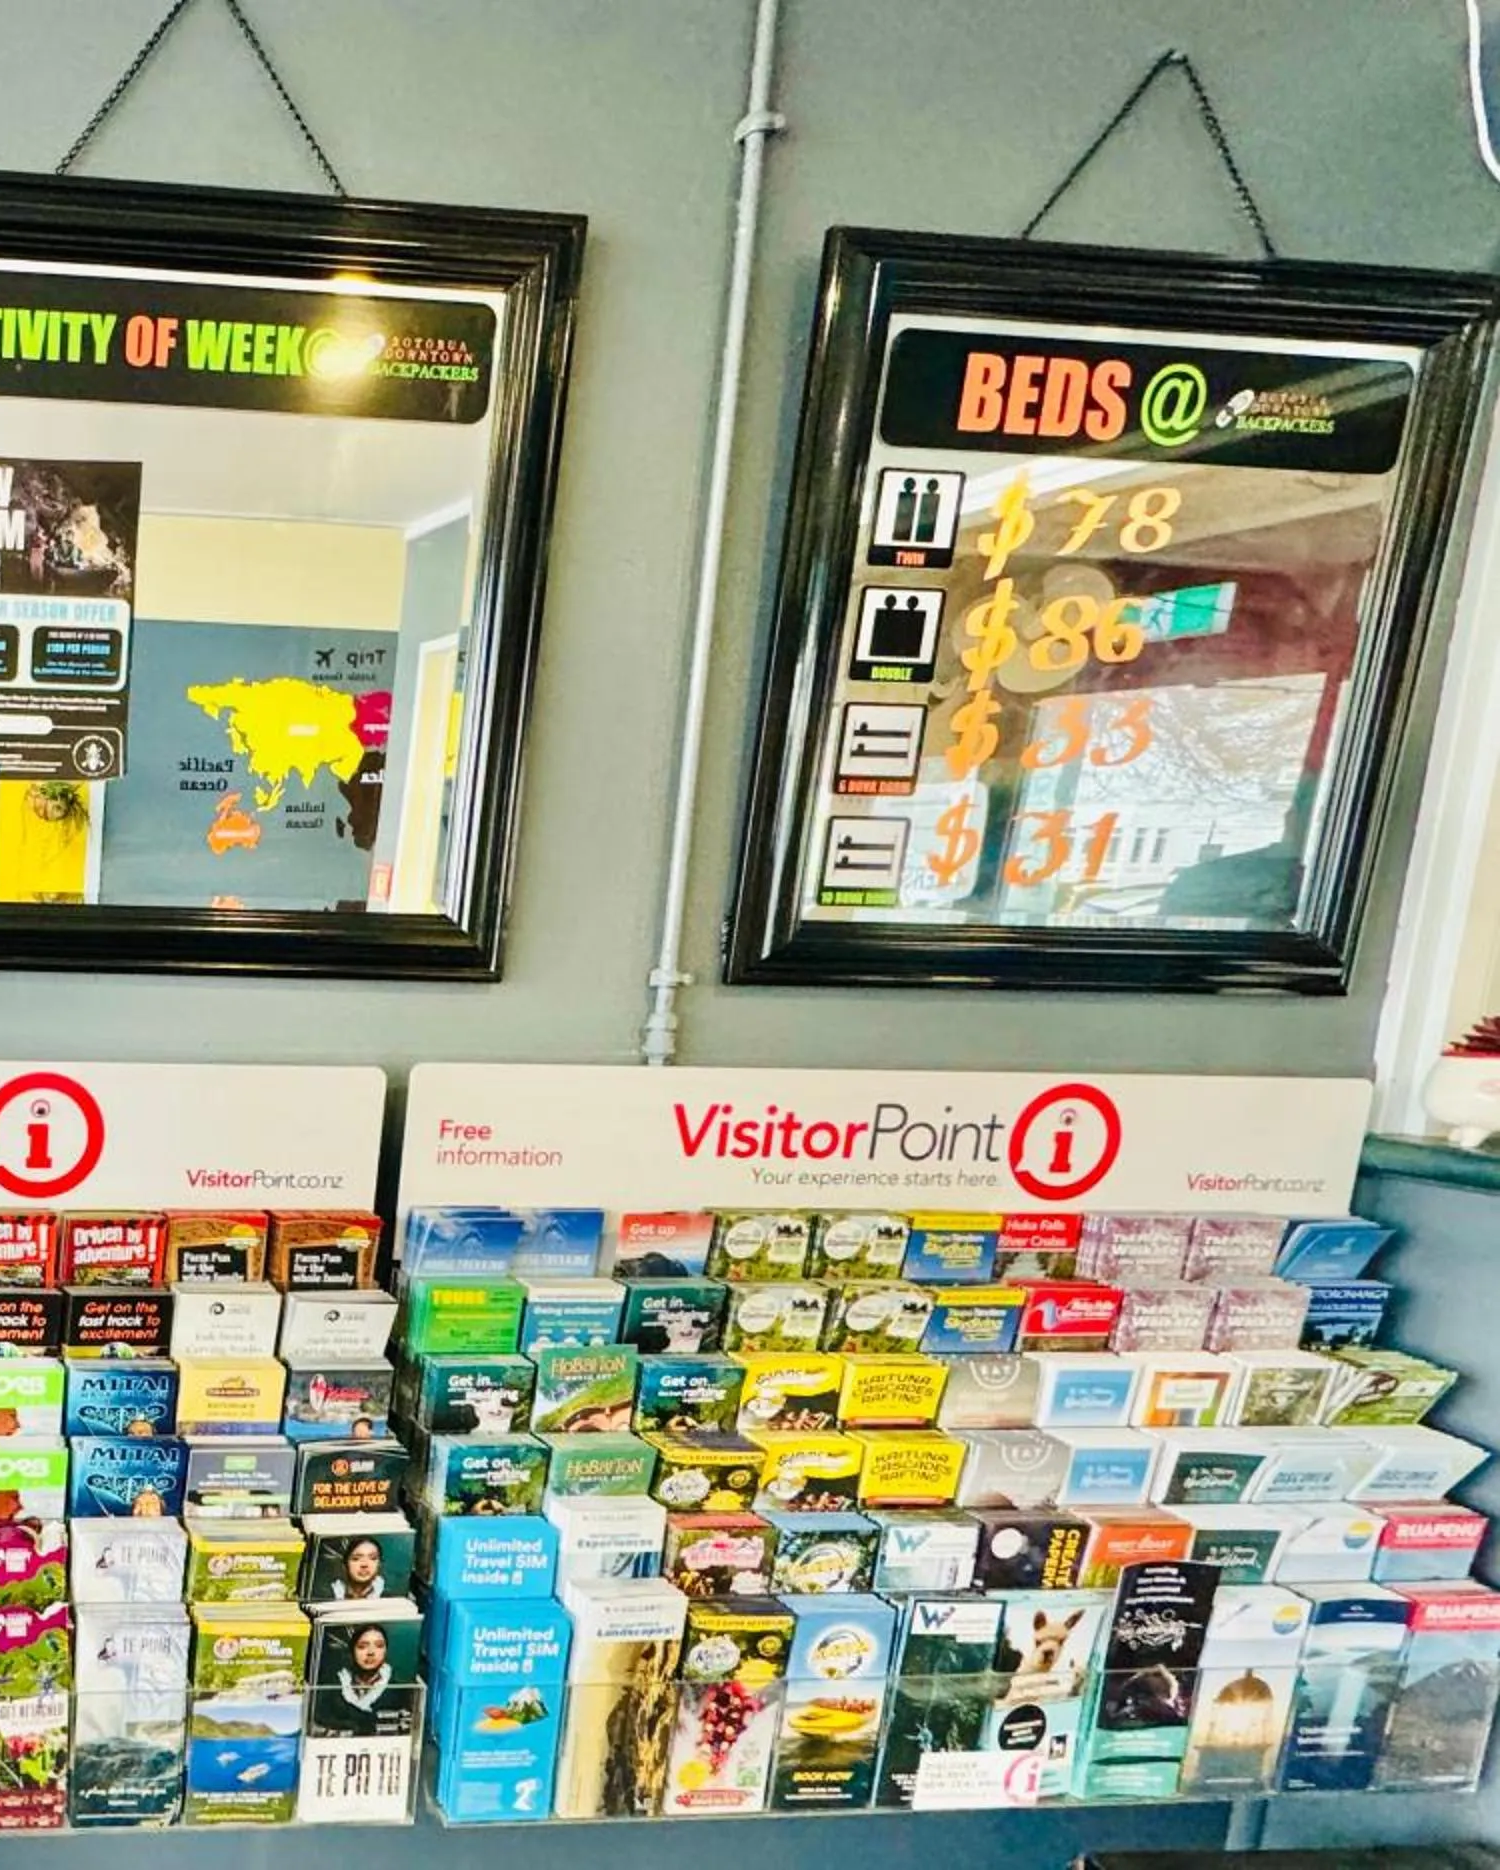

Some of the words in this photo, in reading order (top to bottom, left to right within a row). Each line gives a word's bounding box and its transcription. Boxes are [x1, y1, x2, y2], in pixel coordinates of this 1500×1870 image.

[125, 315, 179, 369] OF
[957, 351, 1132, 441] BEDS
[1236, 416, 1335, 433] BACKPACKERS
[896, 551, 925, 565] TWIN
[871, 667, 913, 681] DOUBLE
[439, 1120, 491, 1141] Free
[673, 1102, 1004, 1162] VisitorPoint
[436, 1144, 563, 1167] information
[185, 1169, 344, 1190] VisitorPoint.co.nz
[751, 1167, 793, 1186] Your
[798, 1168, 899, 1189] experience
[904, 1169, 952, 1187] starts
[630, 1222, 656, 1237] Get
[20, 1301, 43, 1314] the
[85, 1302, 112, 1315] Get
[113, 1303, 132, 1314] on
[135, 1301, 158, 1314] the
[642, 1297, 667, 1309] Get
[32, 1315, 46, 1327] to
[78, 1315, 105, 1327] fast
[106, 1315, 143, 1327] track
[146, 1315, 161, 1327] to
[79, 1327, 158, 1340] excitement
[81, 1377, 169, 1393] MITAI
[448, 1375, 474, 1387] Get
[660, 1375, 687, 1387] Get
[91, 1447, 179, 1462] MITAI
[463, 1457, 488, 1469] Get
[334, 1482, 351, 1494] THE
[1396, 1522, 1482, 1539] RUAPEHU
[466, 1539, 543, 1552] Unlimited
[466, 1554, 512, 1569] Travel
[515, 1555, 548, 1570] SIM
[1056, 1529, 1081, 1588] CREATE
[473, 1628, 553, 1641] Unlimited
[473, 1643, 521, 1657] Travel
[526, 1642, 560, 1657] SIM
[316, 1754, 338, 1797] TE
[793, 1772, 824, 1782] BOOK
[826, 1772, 854, 1782] NOW
